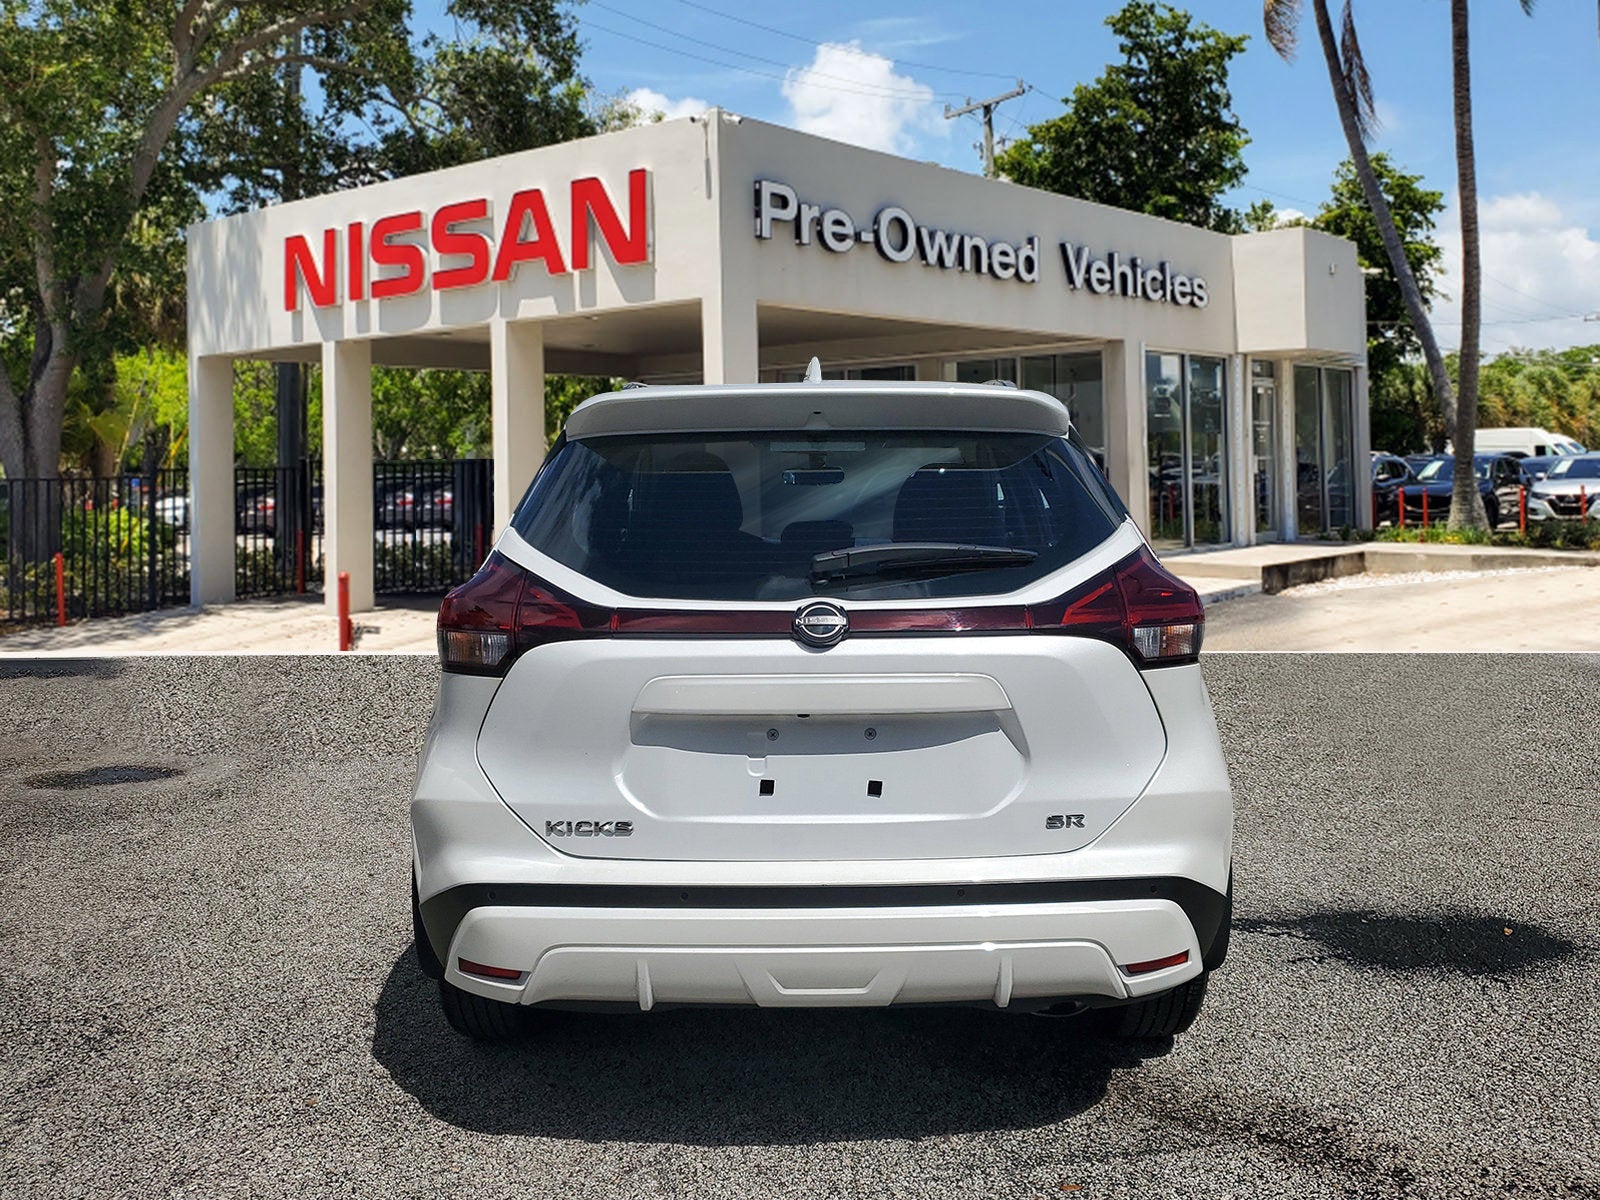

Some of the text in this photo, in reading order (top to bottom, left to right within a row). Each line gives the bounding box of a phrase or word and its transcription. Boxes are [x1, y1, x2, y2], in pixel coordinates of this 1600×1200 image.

[284, 168, 648, 311] NISSAN
[754, 180, 1209, 308] Pre-Owned Vehicles
[545, 820, 634, 837] KICKS
[1046, 814, 1085, 829] SR
